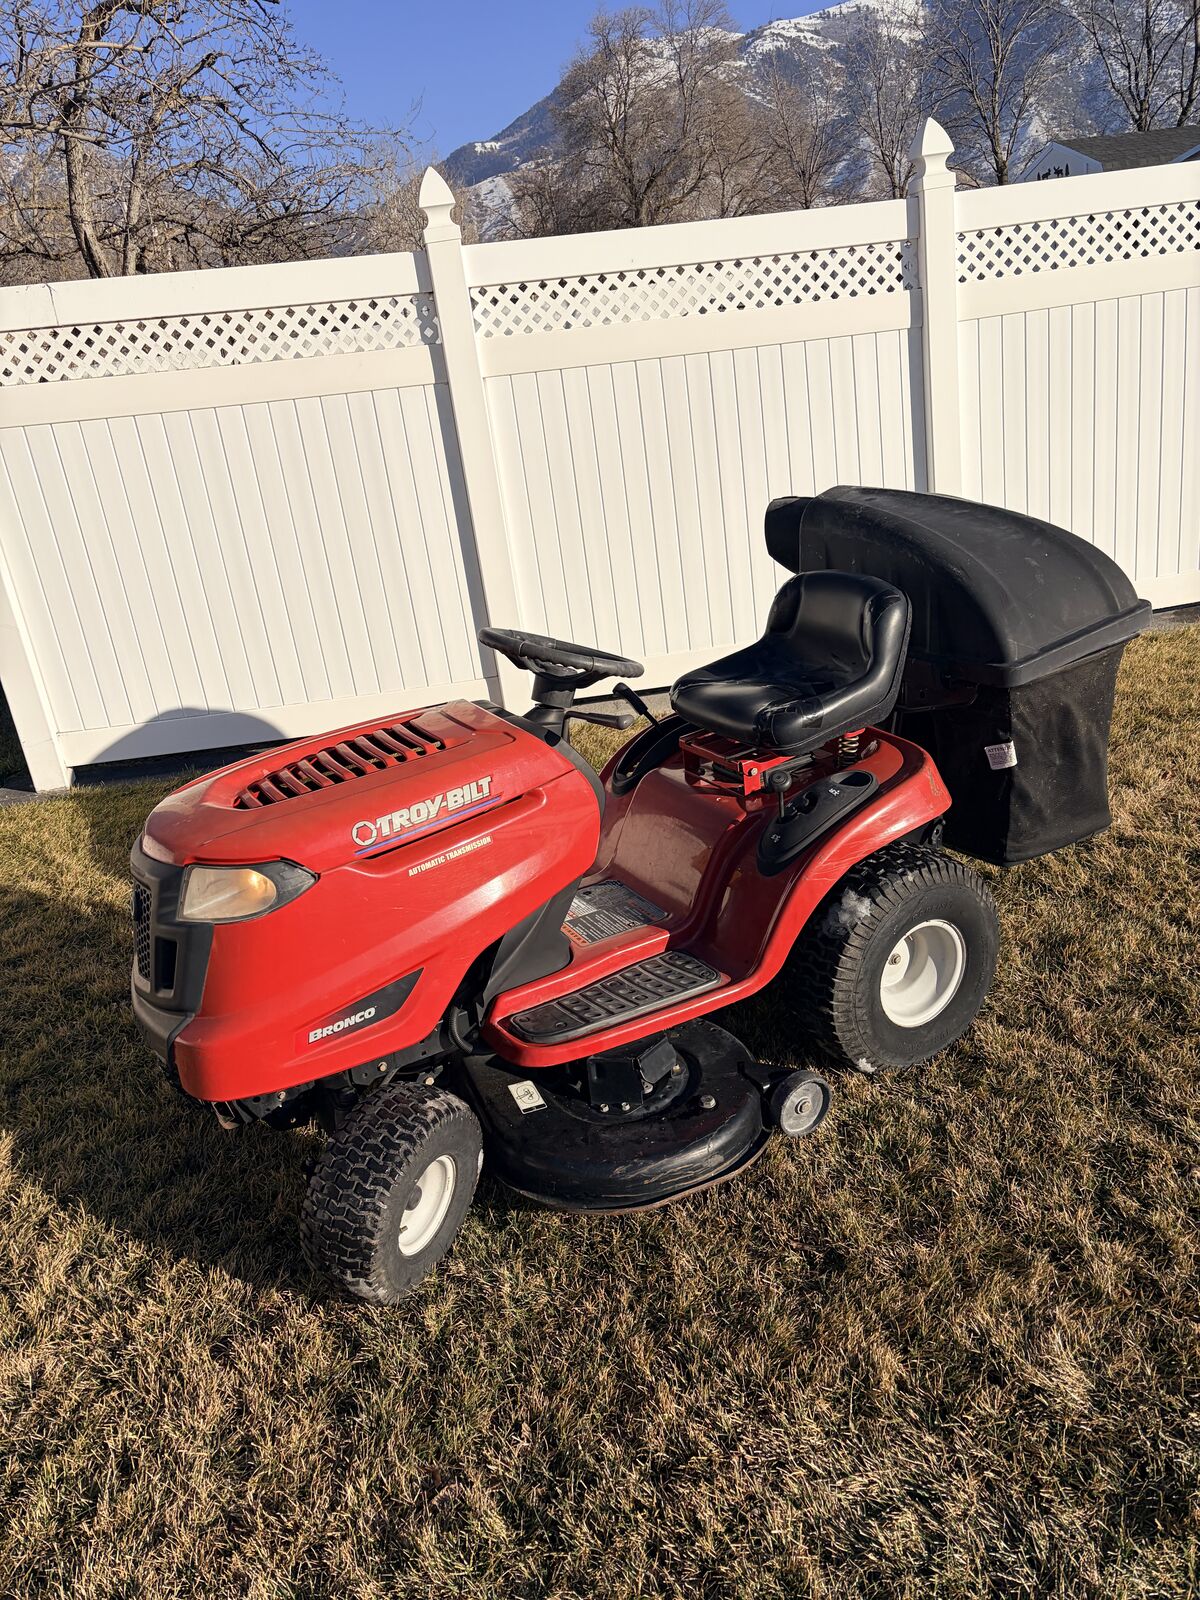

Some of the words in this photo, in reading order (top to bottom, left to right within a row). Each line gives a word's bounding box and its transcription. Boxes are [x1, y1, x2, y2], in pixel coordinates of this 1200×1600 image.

[376, 776, 492, 837] TROY-BILT
[408, 855, 446, 877] AUTOMATIC
[445, 836, 492, 861] TRANSMISSION
[308, 1007, 376, 1044] BRONCO
